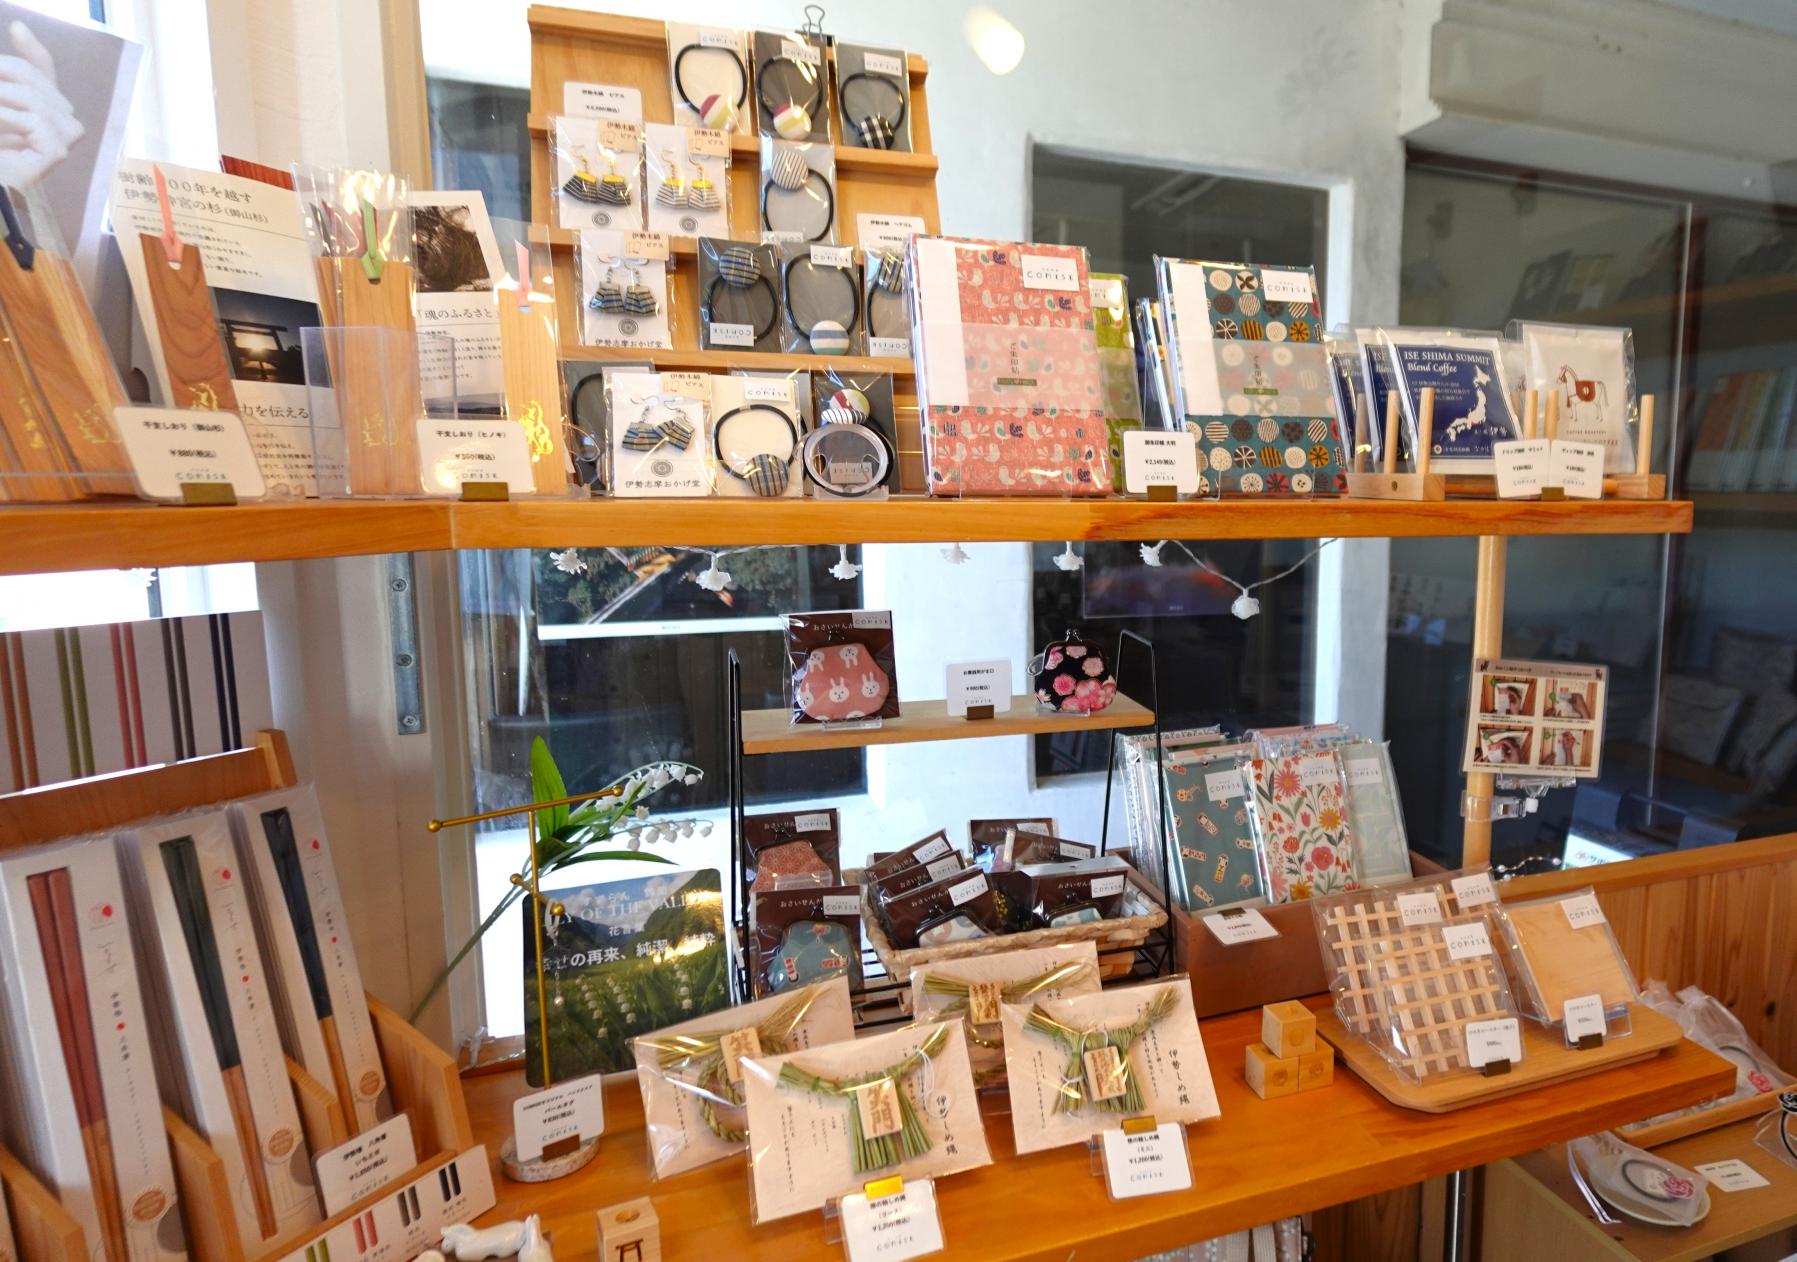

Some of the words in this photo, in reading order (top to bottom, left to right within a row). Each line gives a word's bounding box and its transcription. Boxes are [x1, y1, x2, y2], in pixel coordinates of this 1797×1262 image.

[1404, 351, 1419, 360] ISE
[1422, 352, 1453, 361] SHIMA
[1456, 353, 1490, 365] SUMMIT
[1407, 362, 1431, 371] Blend
[1433, 363, 1457, 376] Coffee
